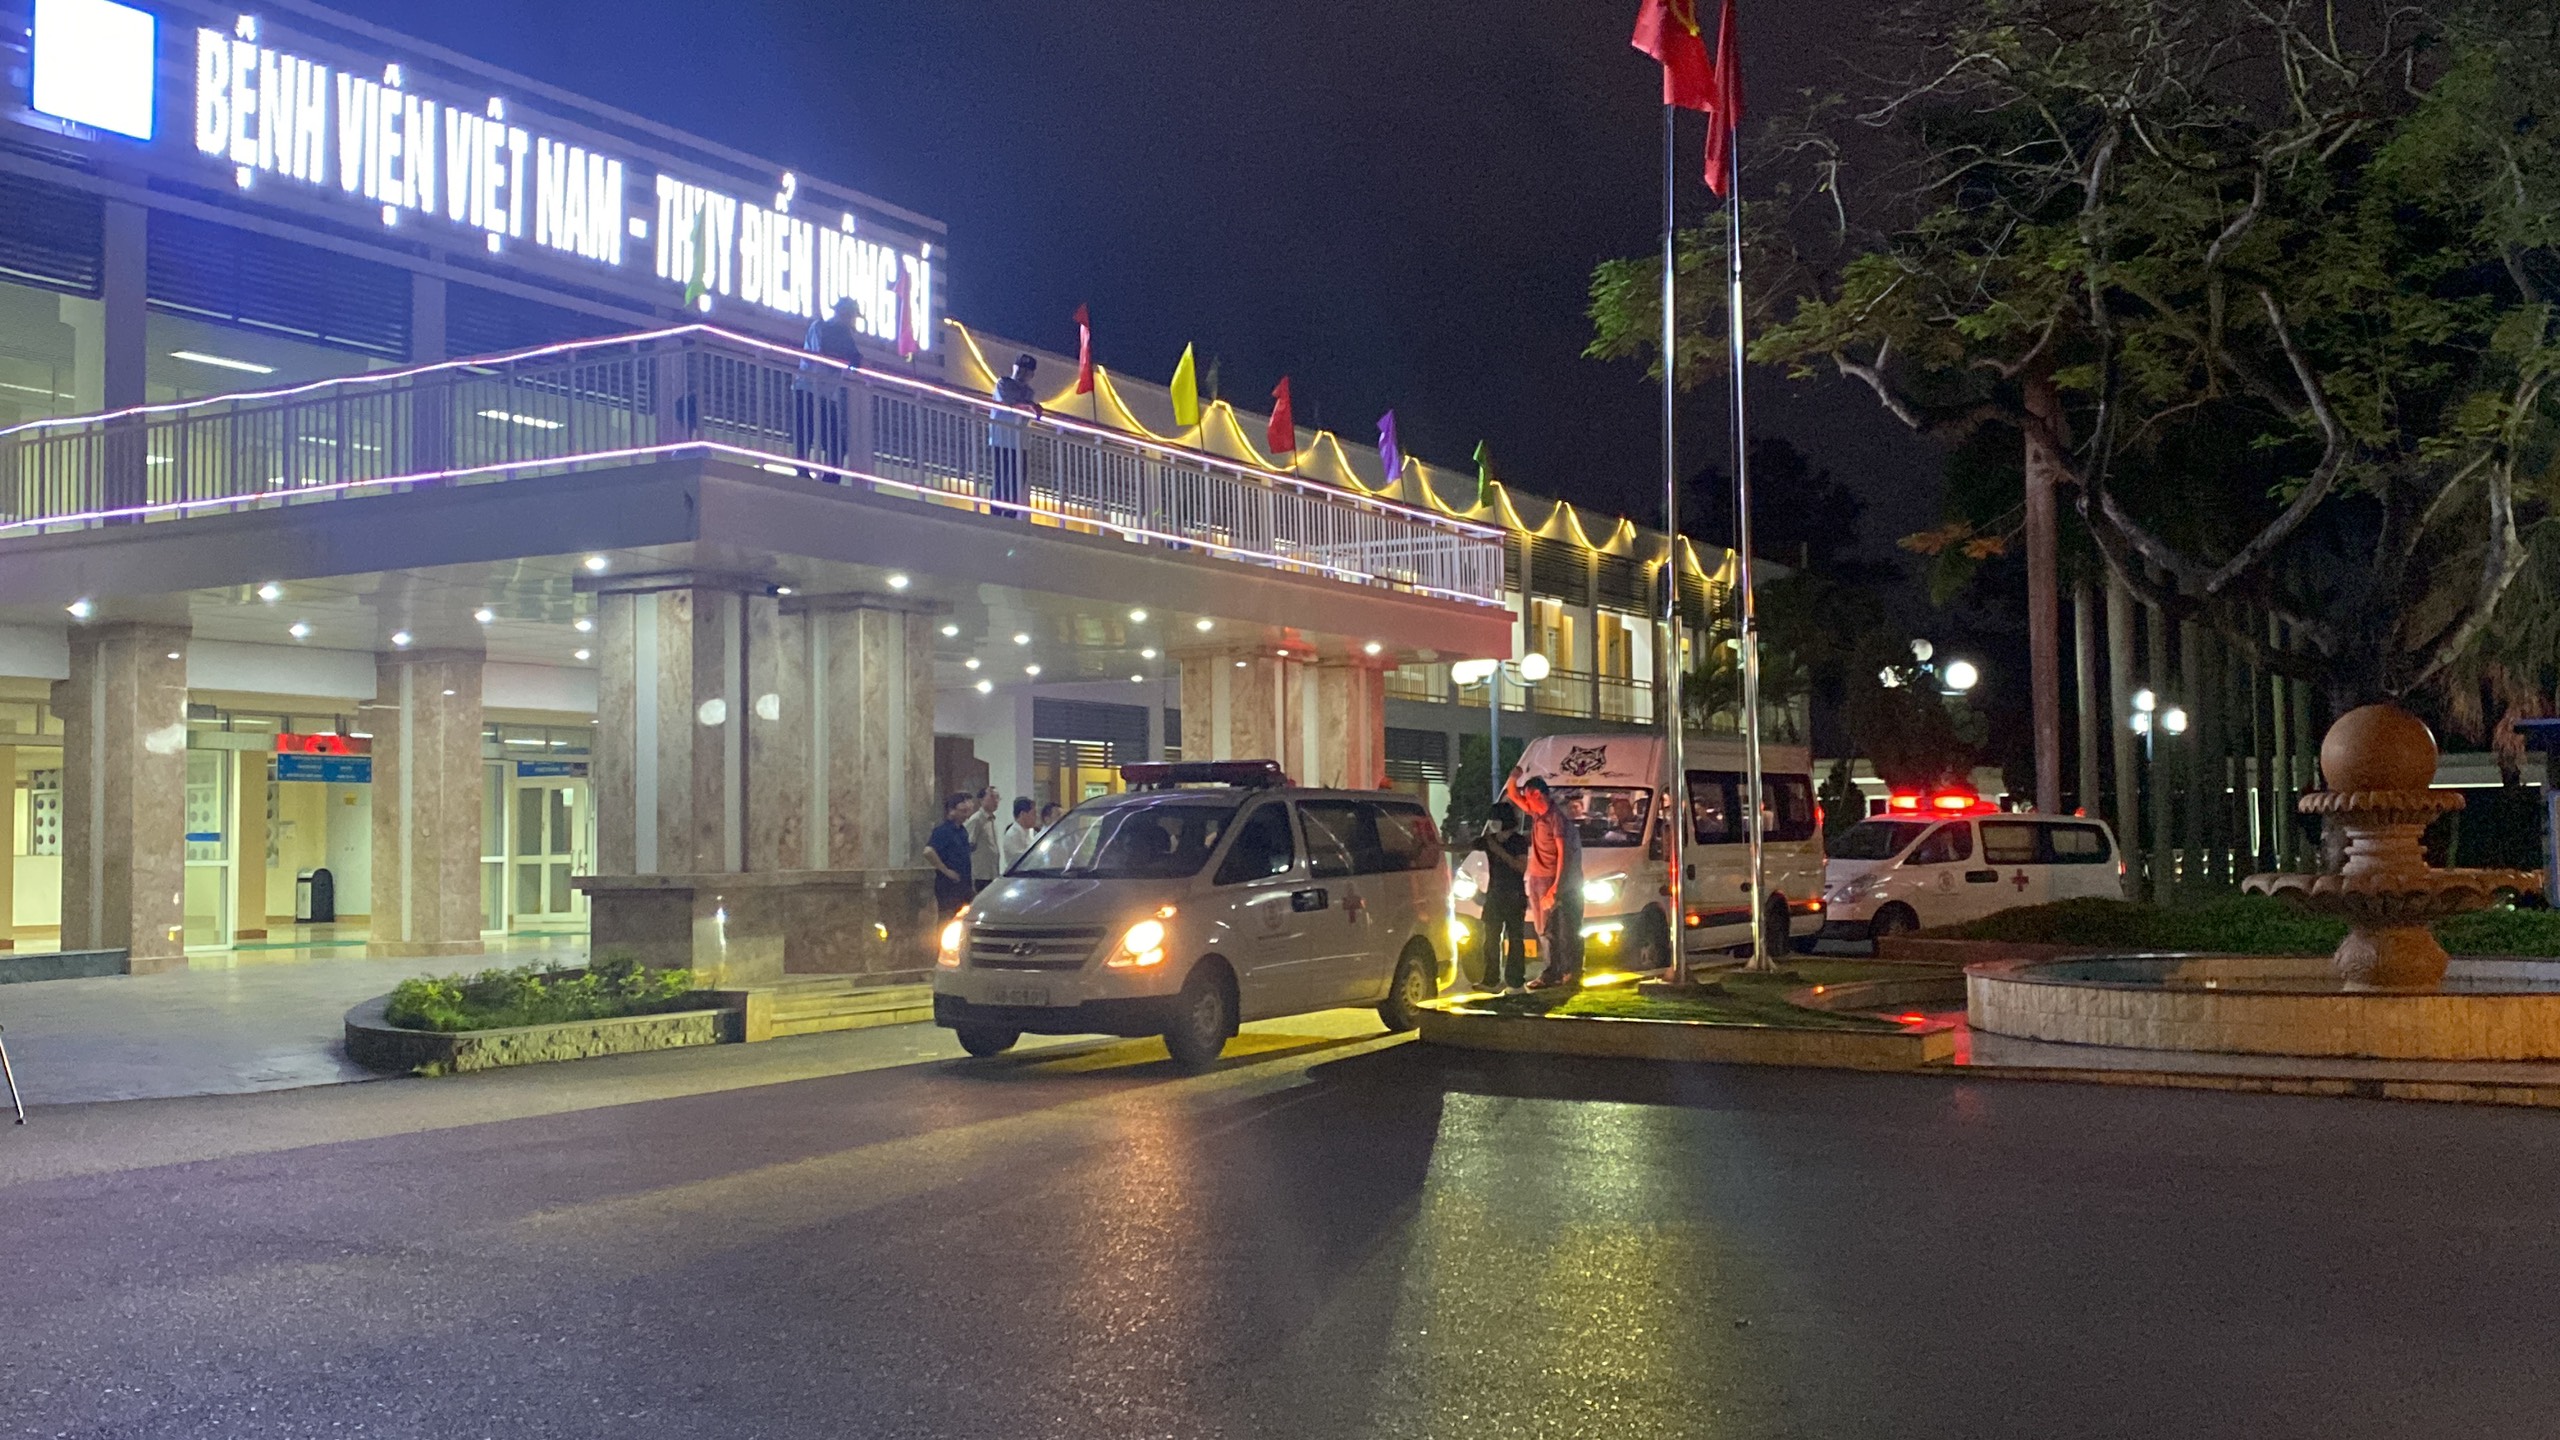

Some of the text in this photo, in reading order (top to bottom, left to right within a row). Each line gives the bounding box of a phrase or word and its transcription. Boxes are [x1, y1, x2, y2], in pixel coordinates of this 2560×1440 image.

[196, 14, 328, 189] BỆNH
[337, 63, 436, 227] VIỆN
[445, 97, 530, 253] VIỆT
[535, 137, 623, 266] NAM
[739, 172, 813, 318] ĐIỂN
